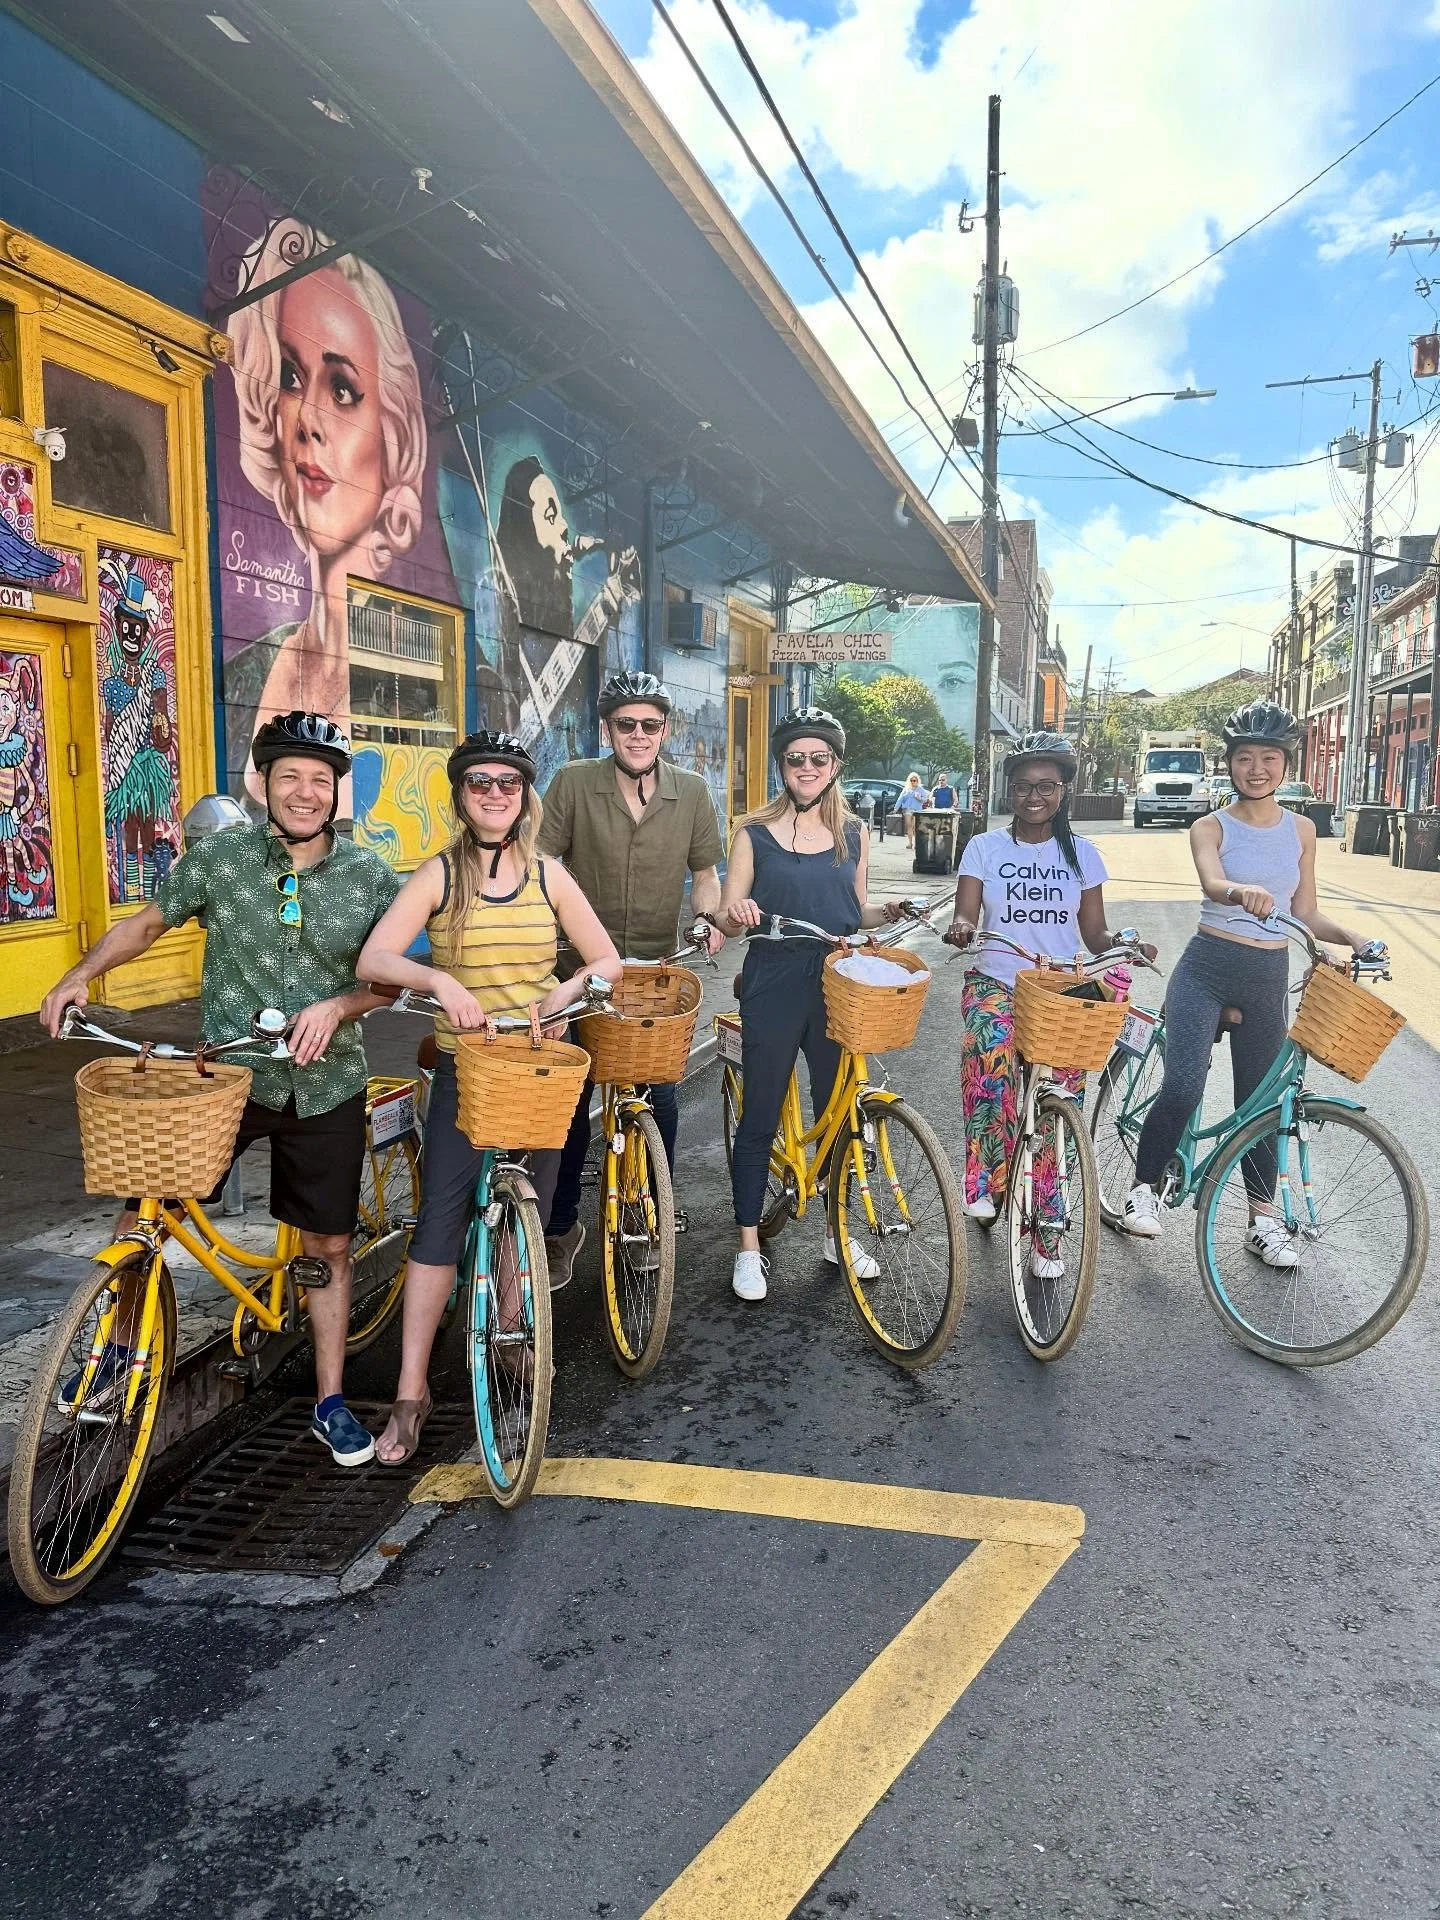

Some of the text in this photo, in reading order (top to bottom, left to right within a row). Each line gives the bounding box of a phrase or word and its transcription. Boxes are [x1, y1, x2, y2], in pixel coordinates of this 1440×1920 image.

[226, 530, 304, 588] Samantha
[236, 575, 300, 606] FISH
[776, 633, 882, 649] FAVELA CHIC
[772, 649, 887, 661] PIZZA TACOS WINGS
[998, 862, 1070, 881] Calvin
[1006, 881, 1063, 901] Klein
[1000, 904, 1069, 925] Jeans
